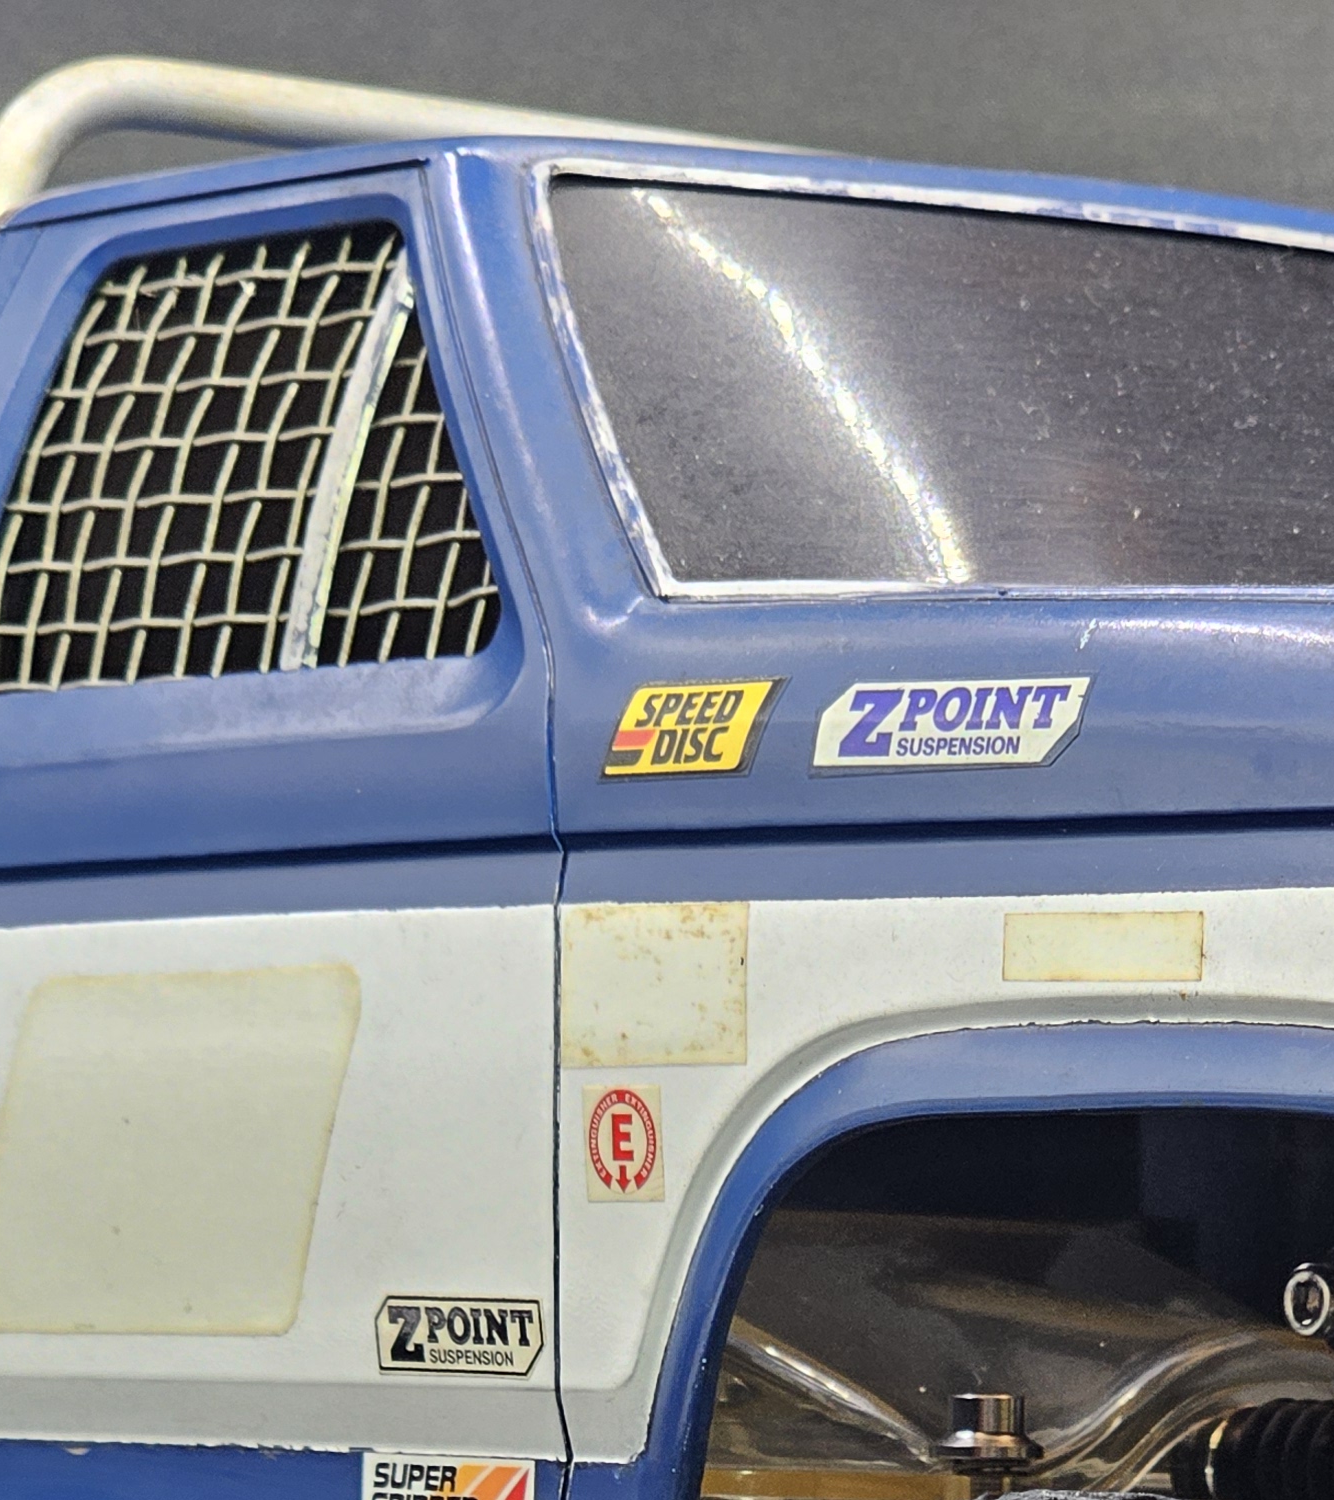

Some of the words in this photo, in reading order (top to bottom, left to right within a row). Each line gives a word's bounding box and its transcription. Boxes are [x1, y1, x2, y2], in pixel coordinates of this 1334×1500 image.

[634, 689, 744, 728] SPEED
[649, 727, 729, 766] DISC
[896, 735, 1021, 757] SUSPENSION
[590, 1092, 619, 1179] EXTINGUISHER
[610, 1112, 634, 1162] E
[624, 1092, 656, 1179] EXTINGUISHER
[428, 1348, 515, 1367] SUSPENSION
[372, 1462, 458, 1492] SUPER
